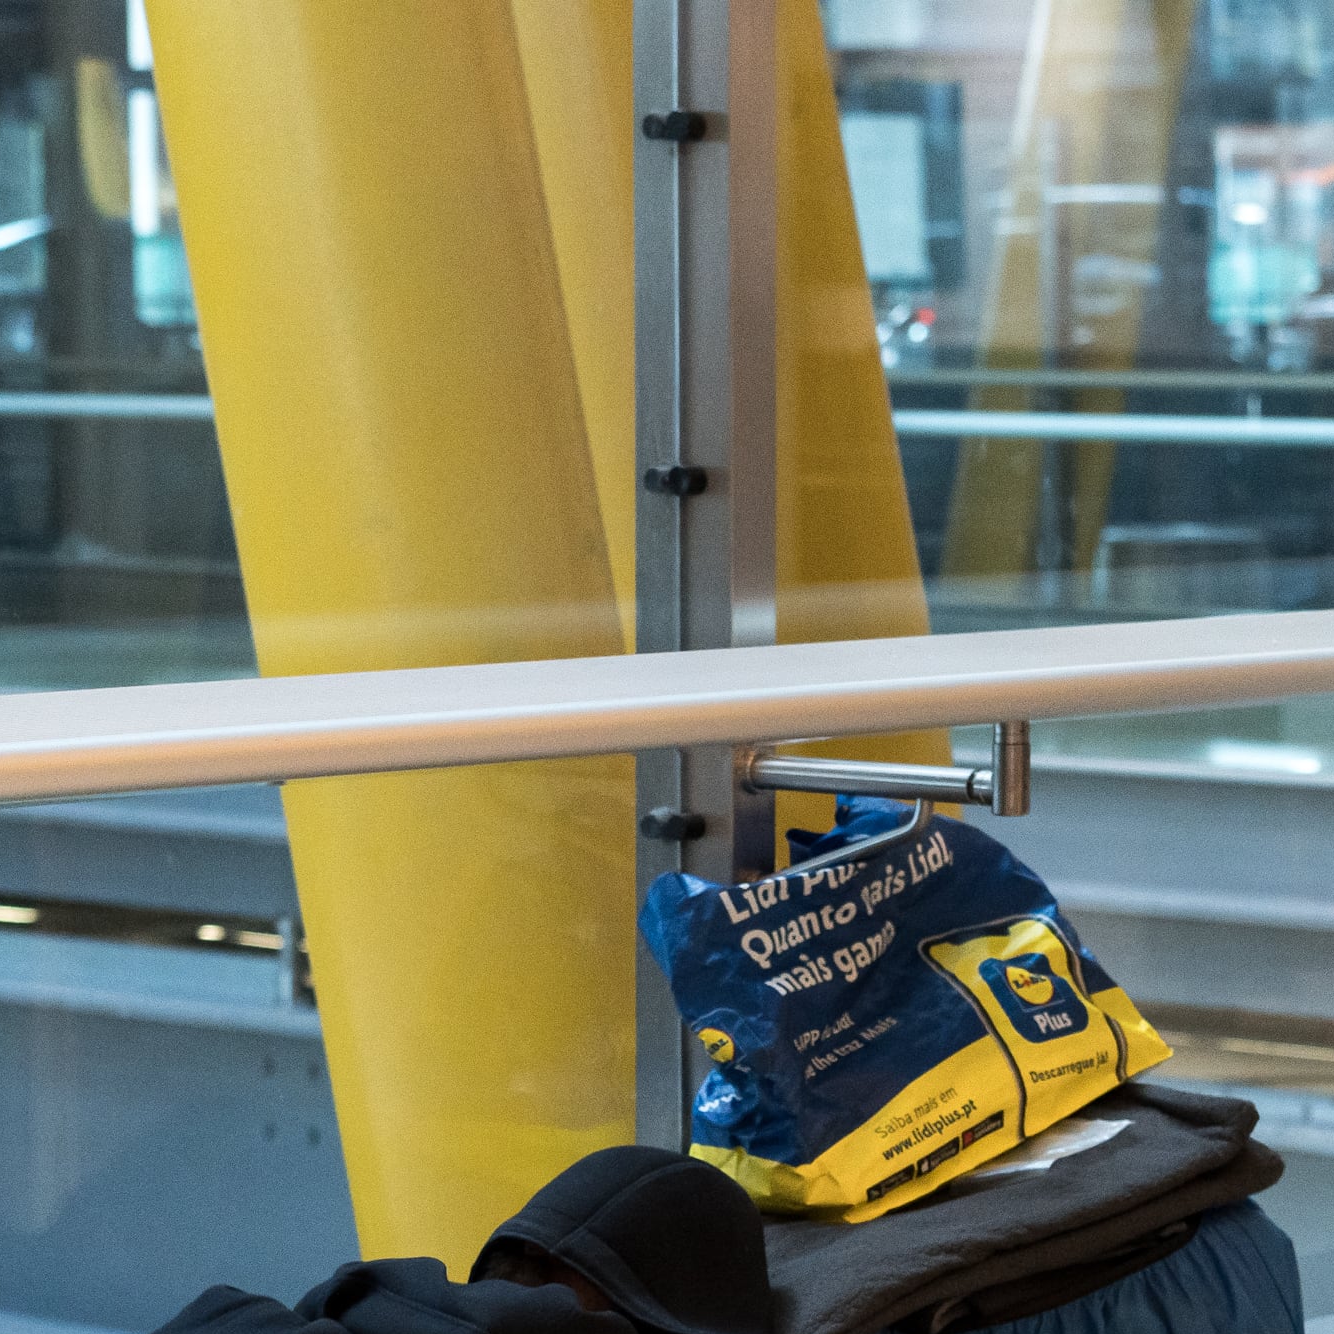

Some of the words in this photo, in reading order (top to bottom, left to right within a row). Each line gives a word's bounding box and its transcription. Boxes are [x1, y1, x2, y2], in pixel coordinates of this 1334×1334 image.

[720, 877, 789, 924] Lidl
[800, 861, 867, 896] Plu
[741, 902, 857, 969] Quanto
[765, 955, 833, 996] mais
[1033, 1013, 1072, 1034] Plus
[1029, 1059, 1094, 1083] Descarregue
[875, 1114, 913, 1138] Saiba
[915, 1098, 939, 1118] mais
[883, 1099, 977, 1160] www.lidlplus.pt
